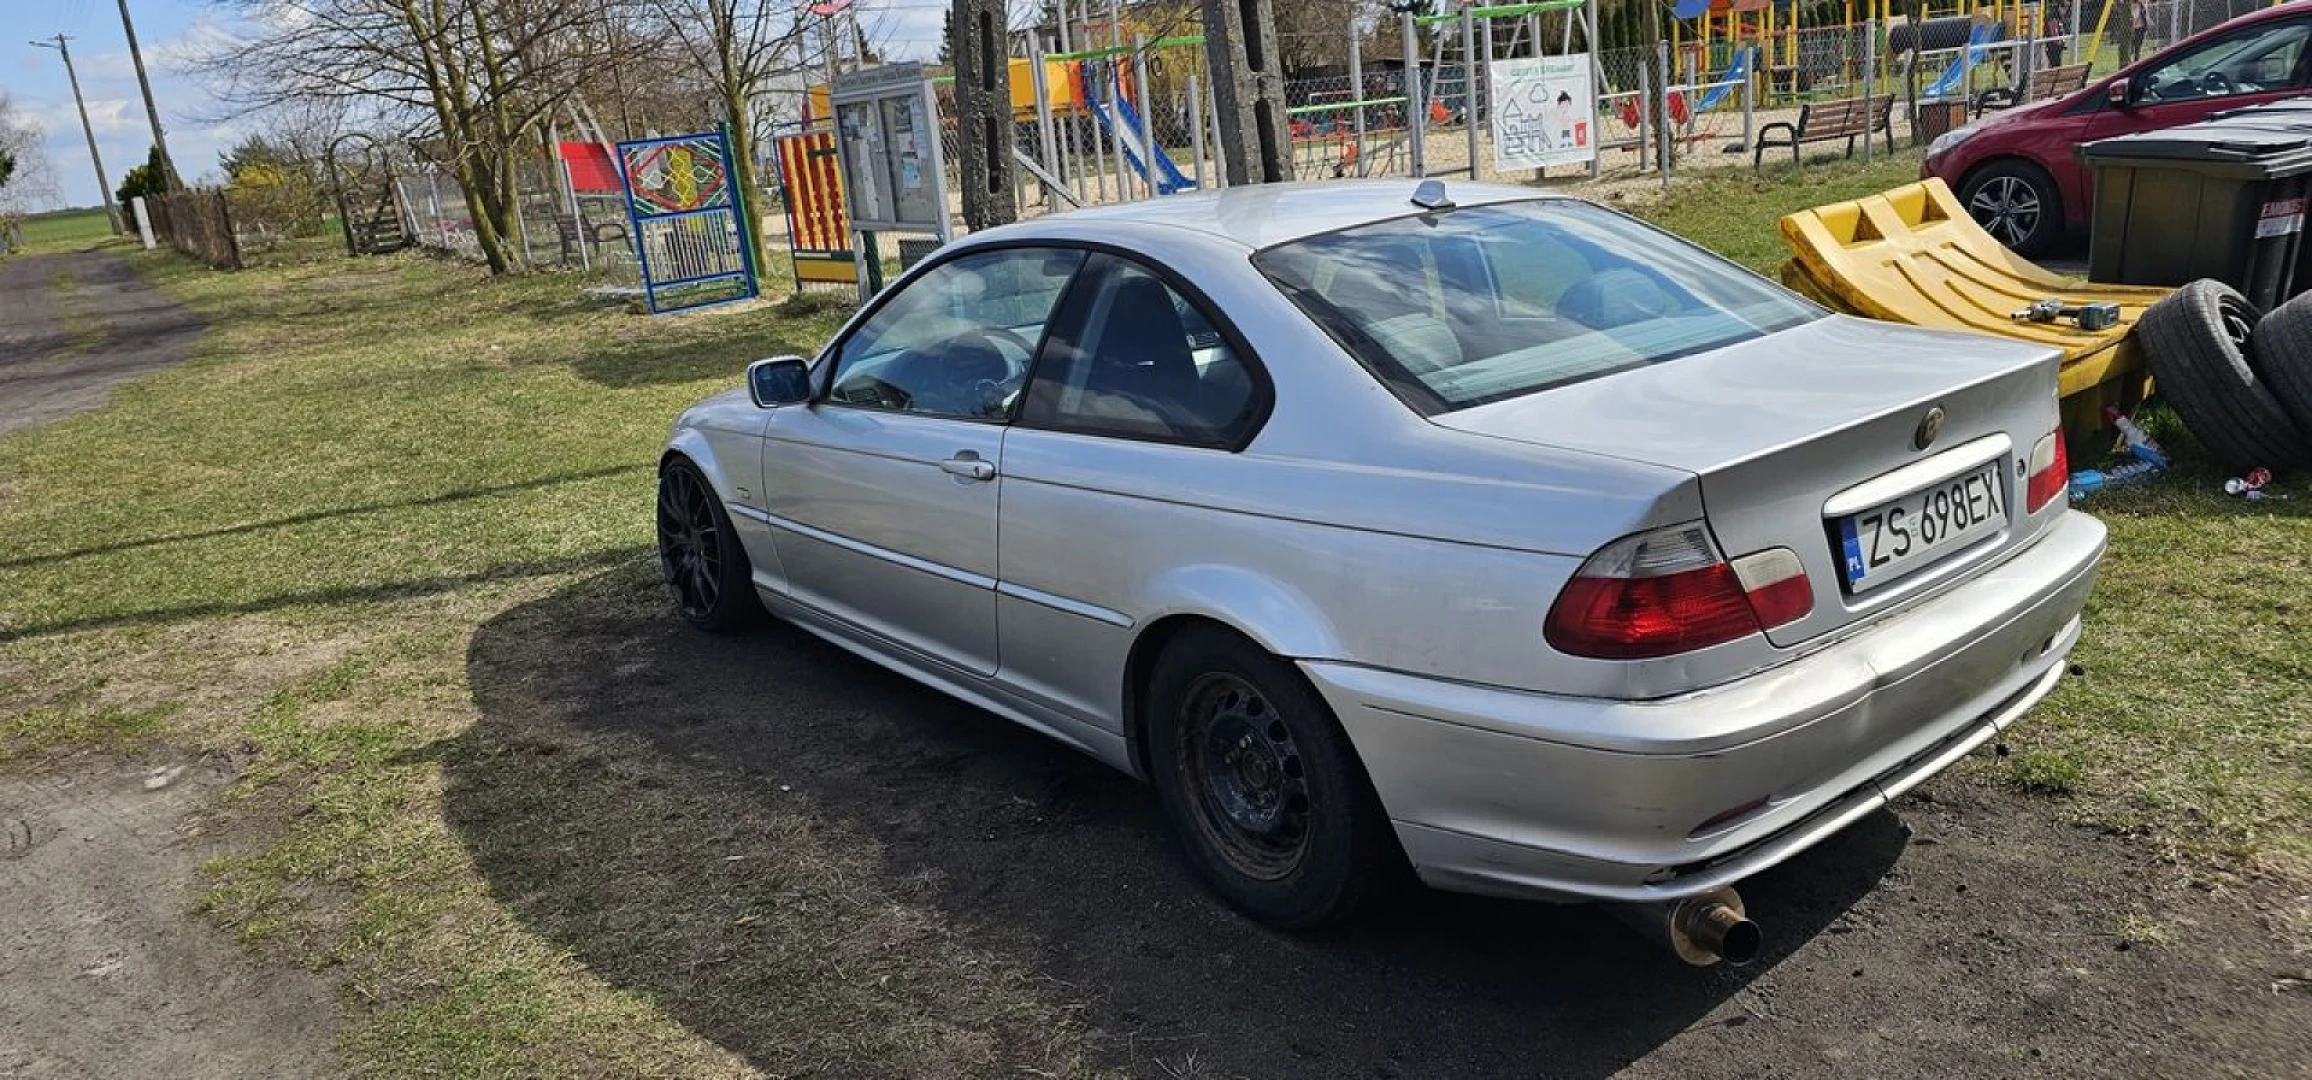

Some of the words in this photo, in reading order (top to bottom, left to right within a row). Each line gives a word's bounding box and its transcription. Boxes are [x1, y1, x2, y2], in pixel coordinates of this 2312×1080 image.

[1862, 506, 1912, 568] ZS
[1921, 469, 2000, 544] 698EX
[1849, 555, 1862, 572] PL
